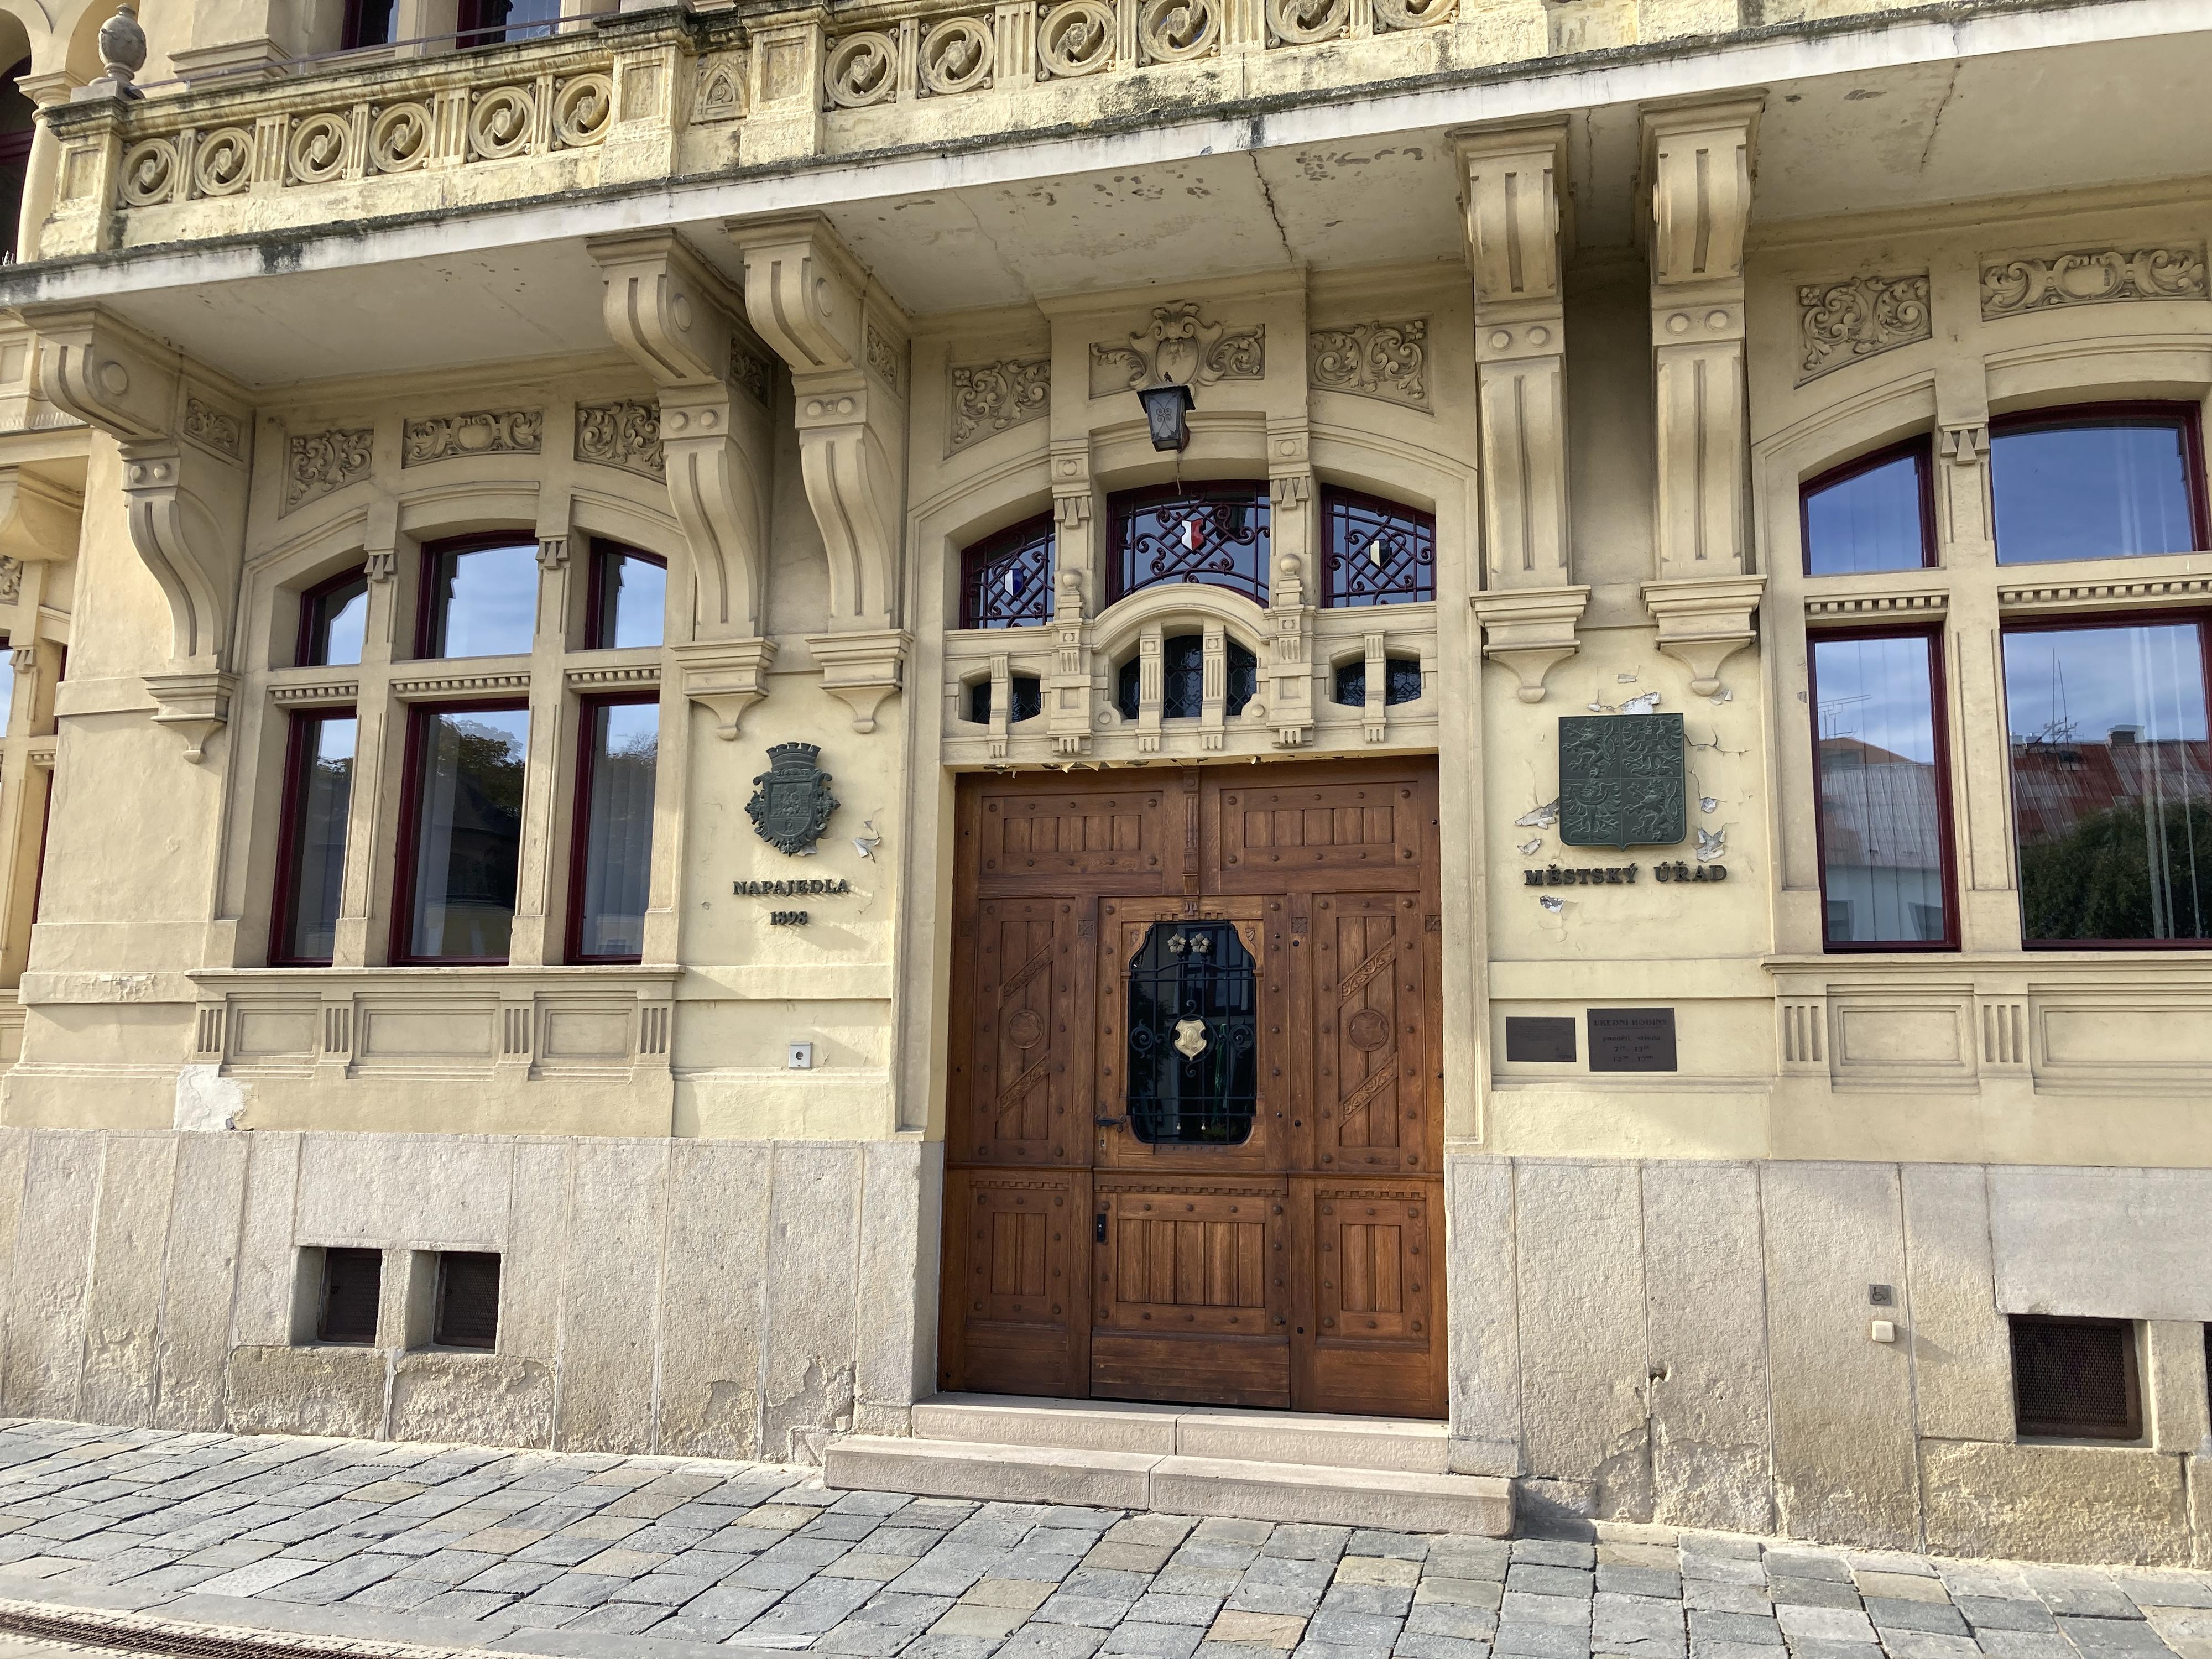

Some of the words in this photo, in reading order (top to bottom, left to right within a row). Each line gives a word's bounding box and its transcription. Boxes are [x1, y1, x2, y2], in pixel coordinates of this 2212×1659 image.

[1524, 862, 1638, 885] MĚSTSKÝ
[1653, 861, 1728, 883] ÚŘAD
[732, 879, 851, 897] NAPAJEDLA
[770, 911, 808, 925] 1898
